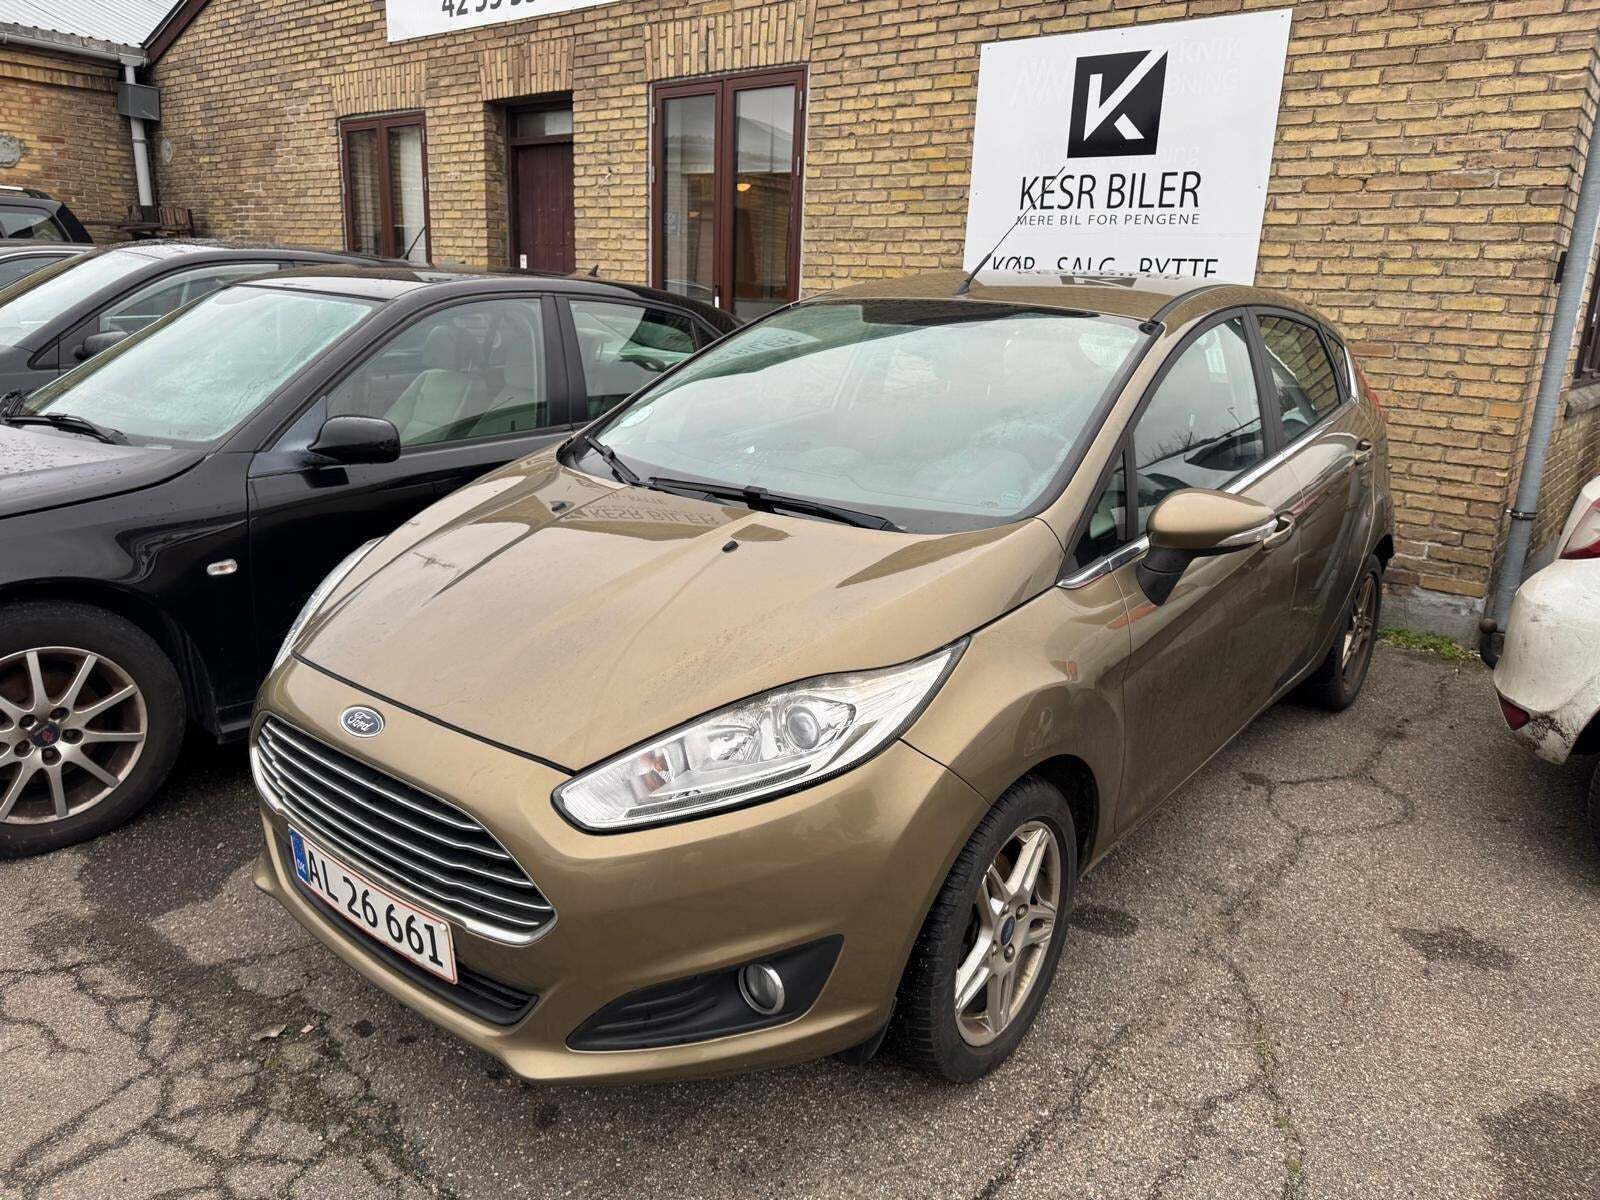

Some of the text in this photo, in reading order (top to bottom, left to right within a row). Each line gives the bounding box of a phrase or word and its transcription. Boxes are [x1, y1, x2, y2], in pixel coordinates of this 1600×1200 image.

[1019, 171, 1202, 211] KESR BILER
[1016, 213, 1201, 226] MERE BIL FOR PENGENE
[308, 850, 444, 967] AL 26 661
